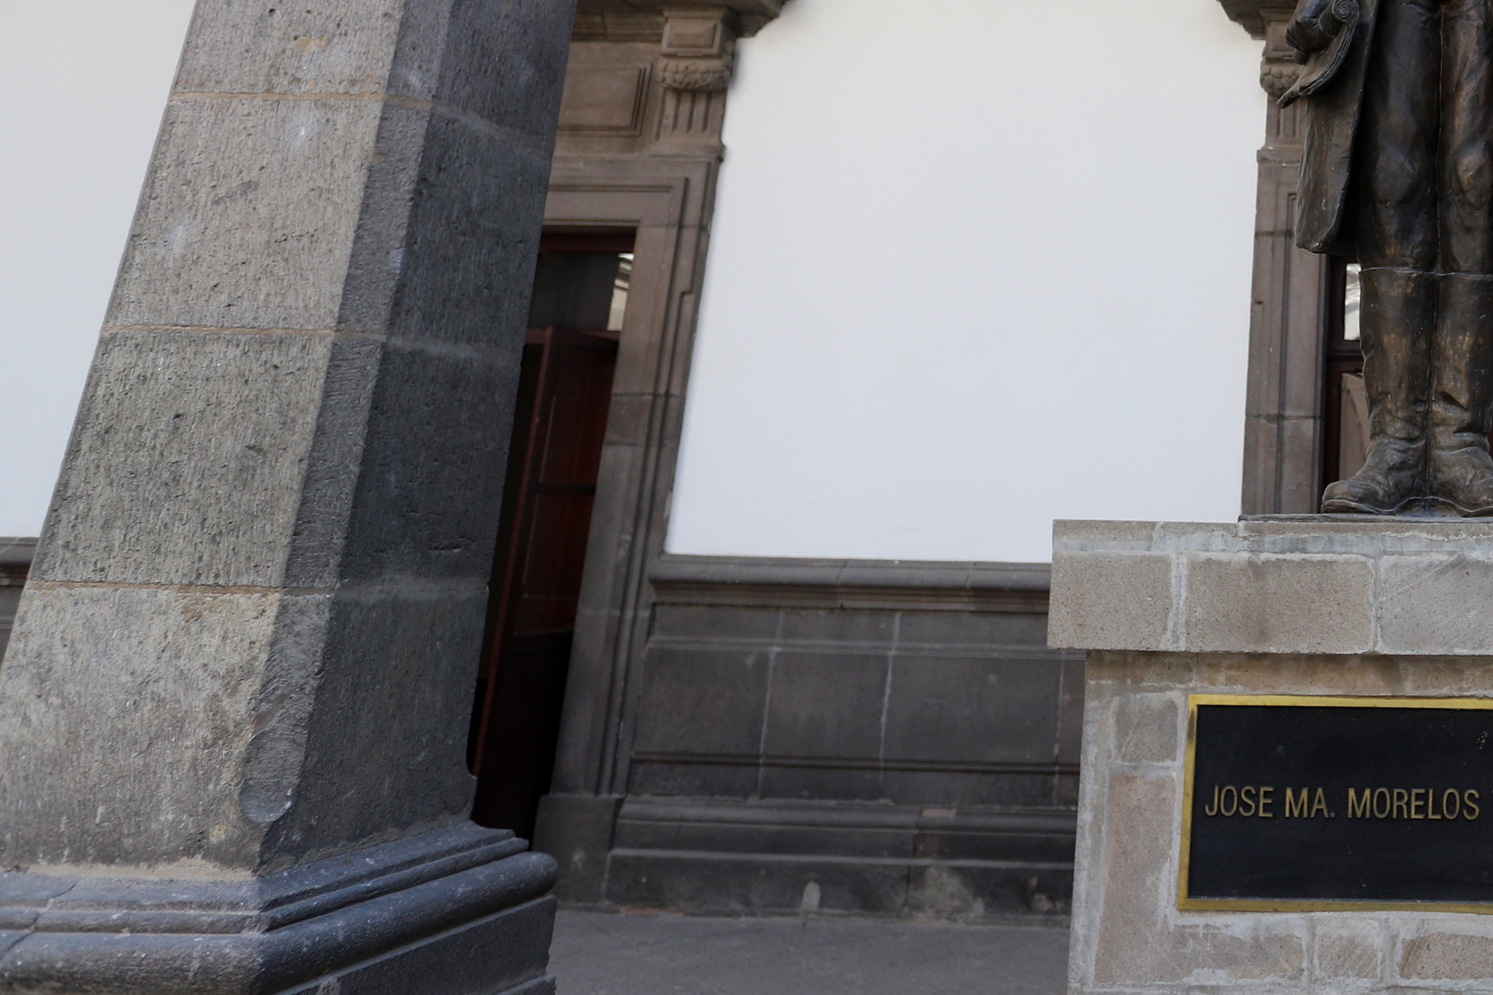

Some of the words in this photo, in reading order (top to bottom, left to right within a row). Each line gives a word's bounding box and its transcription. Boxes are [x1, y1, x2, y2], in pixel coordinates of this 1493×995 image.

[1204, 785, 1274, 818] JOSE
[1283, 787, 1336, 819] MA.
[1347, 787, 1480, 821] MORELOS
